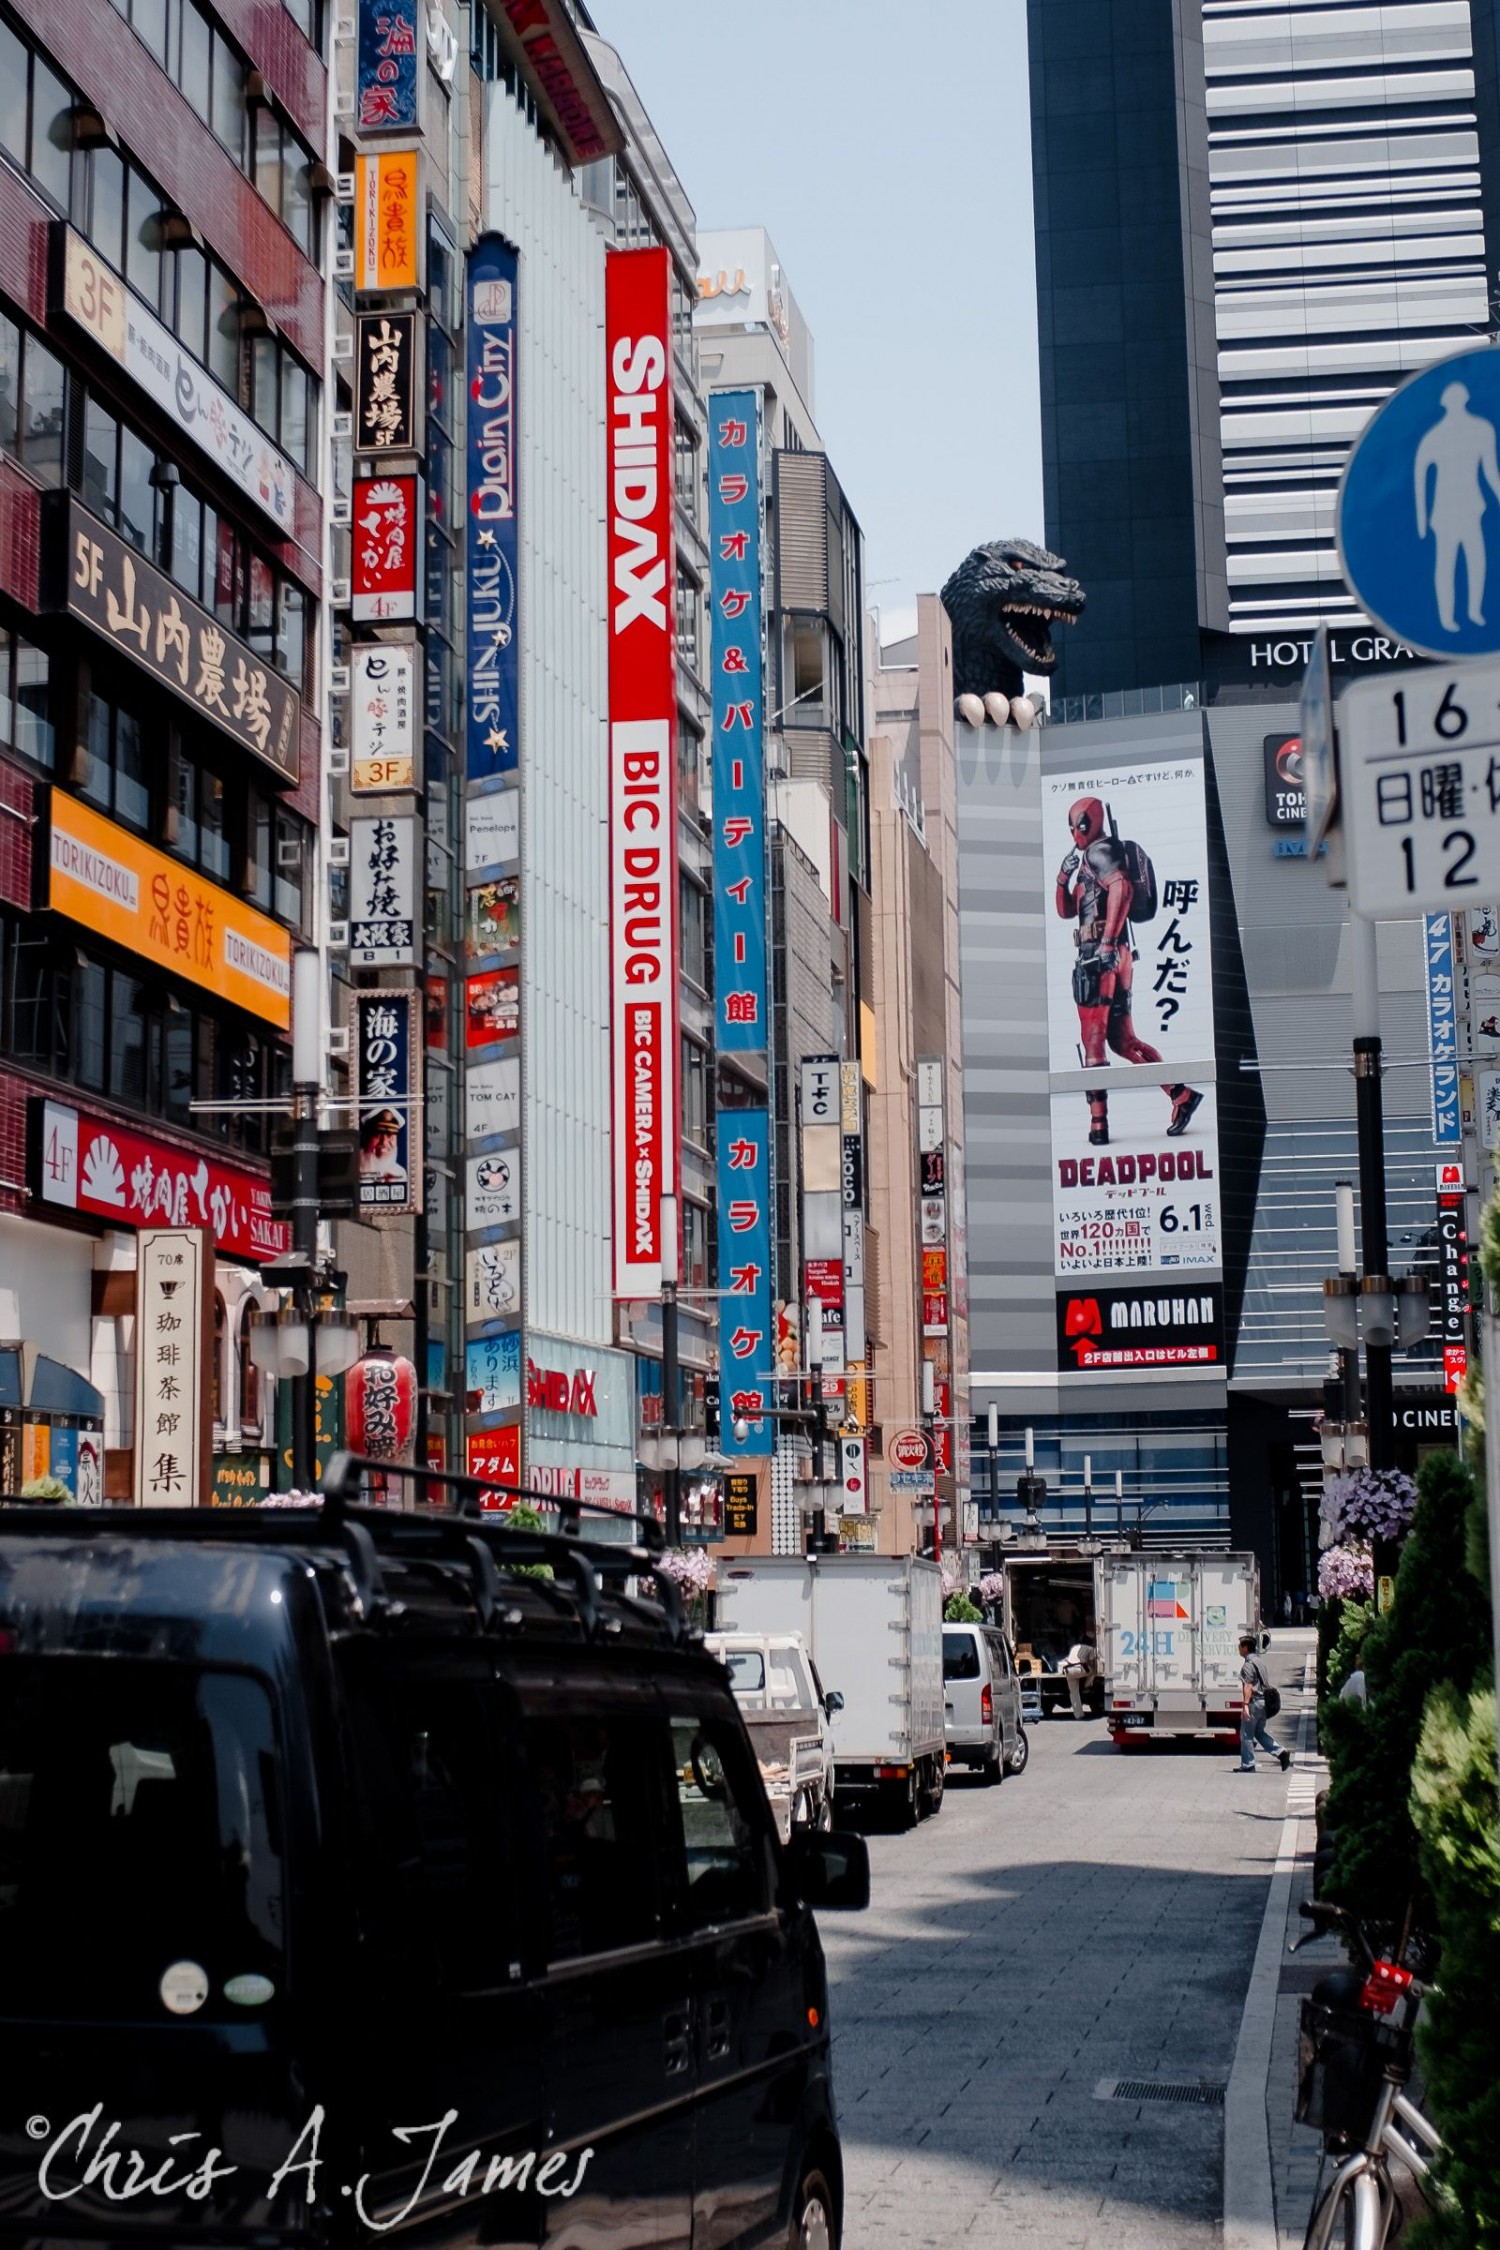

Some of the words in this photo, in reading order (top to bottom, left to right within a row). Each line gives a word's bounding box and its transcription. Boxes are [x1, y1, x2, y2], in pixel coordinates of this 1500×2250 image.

[360, 15, 416, 125] 海の家
[368, 170, 376, 266] TORIKIZOKU
[80, 259, 115, 332] 3F
[365, 319, 402, 430] 山内農場
[374, 429, 395, 446] 5F
[611, 334, 667, 636] SHIDAX
[74, 530, 104, 598] 5F
[358, 510, 384, 589] さかい
[384, 501, 407, 570] 焼肉屋
[369, 597, 398, 618] 4F
[106, 554, 272, 752] 山内農場
[472, 553, 512, 724] SHINJUKU
[1251, 641, 1346, 667] HOTL
[368, 761, 401, 783] 3F
[623, 751, 661, 835] BIC
[54, 833, 131, 902] TORIKIZOKU
[366, 818, 402, 917] お好み焼
[1401, 829, 1480, 893] 12
[354, 921, 410, 947] 大阪家
[623, 847, 662, 986] DRUG
[226, 934, 284, 989] TORIKIZOKU
[365, 1005, 398, 1097] 海の家
[634, 1009, 653, 1047] BIC
[469, 1093, 493, 1102] TOM
[496, 1092, 517, 1101] CAT
[45, 1125, 74, 1184] 4F
[473, 1124, 488, 1133] 4F
[1058, 1150, 1214, 1188] DEADPOOL
[1105, 1187, 1167, 1199] デッドプール
[251, 1216, 284, 1250] SAKAI
[1159, 1204, 1201, 1233] 6.1
[157, 1253, 184, 1266] 70席
[727, 1136, 764, 1424] カラオケ館
[1182, 1255, 1215, 1264] IMAX
[808, 1308, 841, 1324] afe
[1111, 1297, 1214, 1328] MARUHAN
[484, 1337, 500, 1411] あります
[472, 1456, 515, 1475] アダム
[1120, 1631, 1175, 1656] 24H
